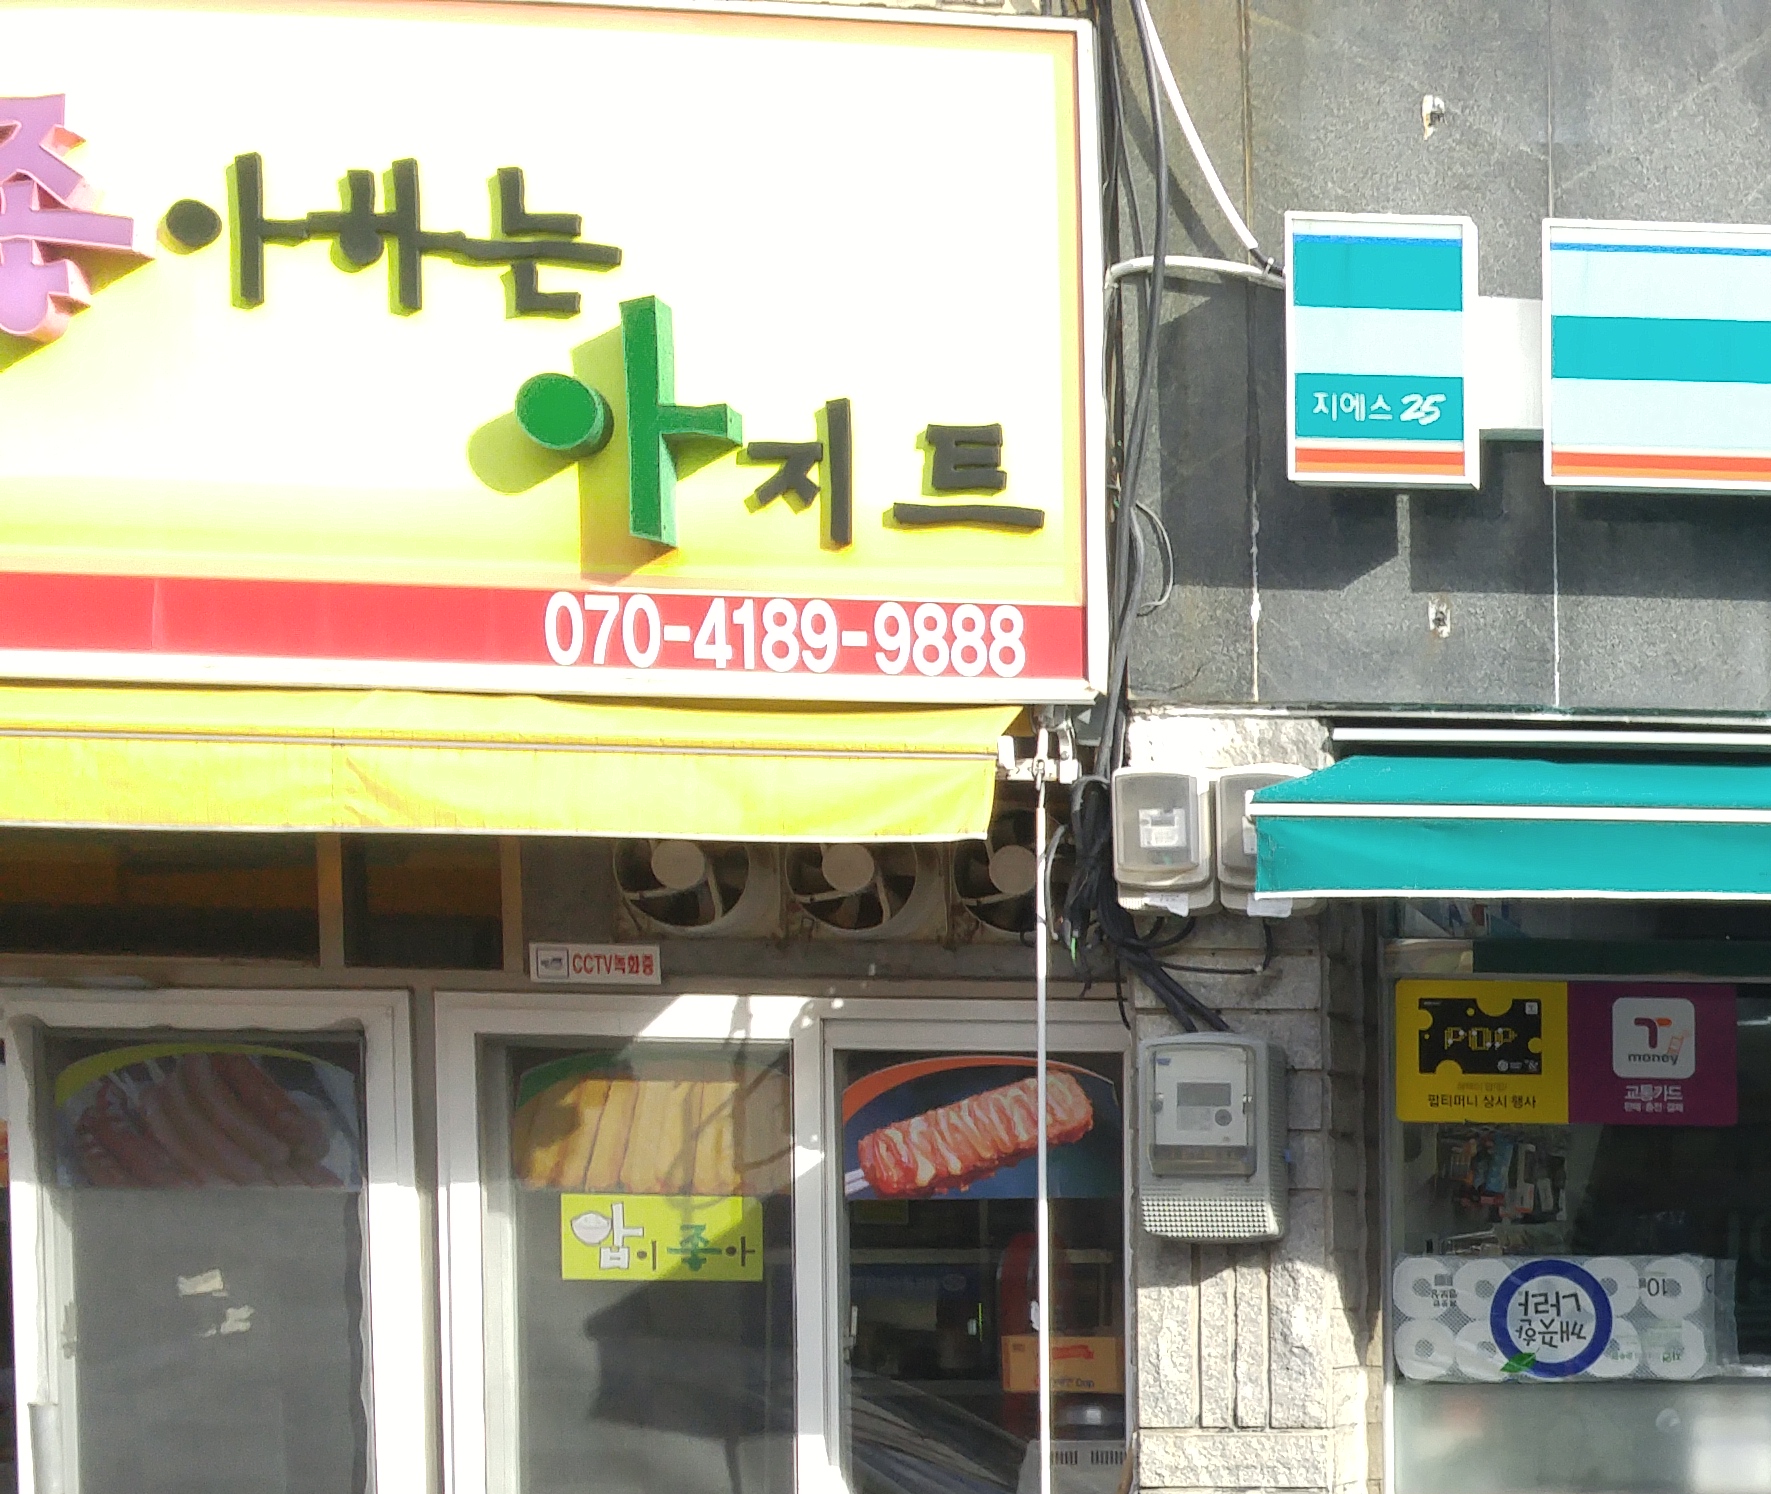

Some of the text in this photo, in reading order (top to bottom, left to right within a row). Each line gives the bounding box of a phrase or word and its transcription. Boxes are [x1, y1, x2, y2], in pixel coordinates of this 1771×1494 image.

[1312, 391, 1447, 426] 지에스 25
[515, 295, 1045, 549] 아지트
[544, 590, 1026, 678] 070-4189-9888
[572, 952, 655, 976] CCTV녹화중
[1444, 1026, 1516, 1051] POP
[1627, 1052, 1680, 1067] money
[1482, 1095, 1509, 1108] 상시
[1624, 1085, 1684, 1101] 교통카드
[1517, 1290, 1582, 1318] 나라
[1514, 1318, 1587, 1349] 깨끗한
